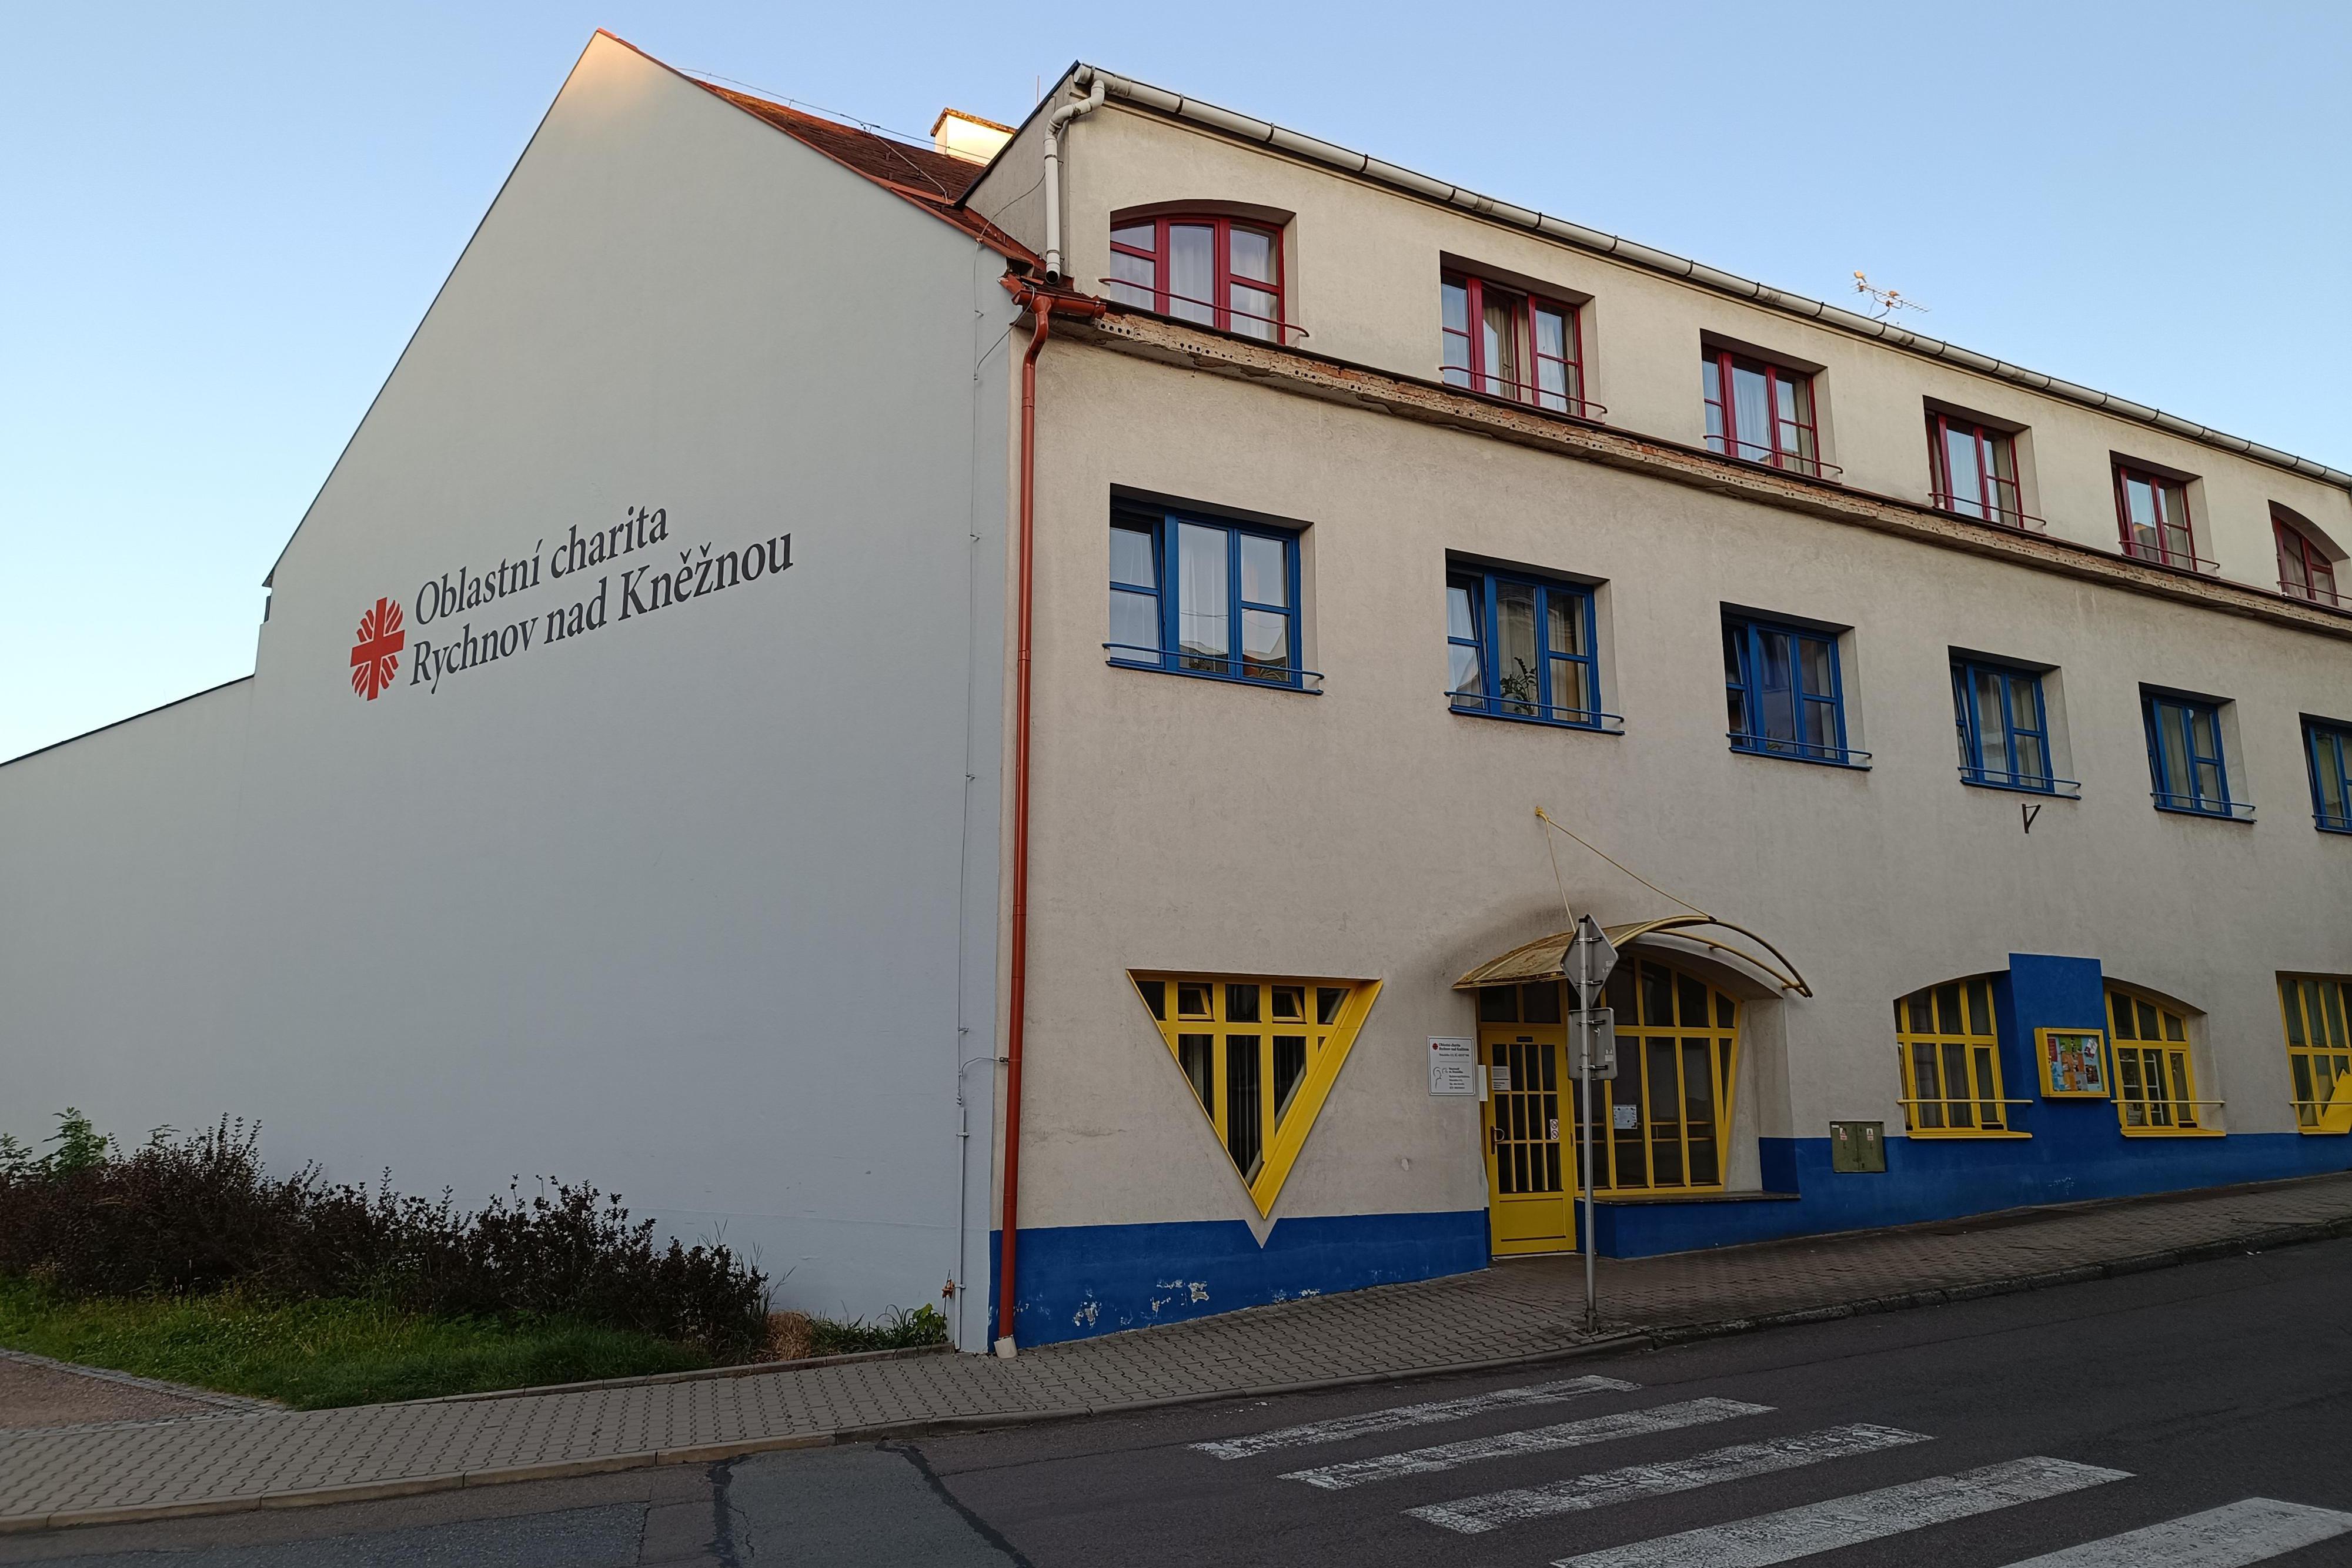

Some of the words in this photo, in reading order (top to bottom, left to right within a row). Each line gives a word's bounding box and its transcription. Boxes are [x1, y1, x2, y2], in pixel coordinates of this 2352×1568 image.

[409, 617, 539, 695] Rychnov
[543, 576, 607, 644] nad
[617, 533, 794, 622] Kněžnou
[416, 539, 543, 625] Oblastní
[551, 506, 669, 579] charita
